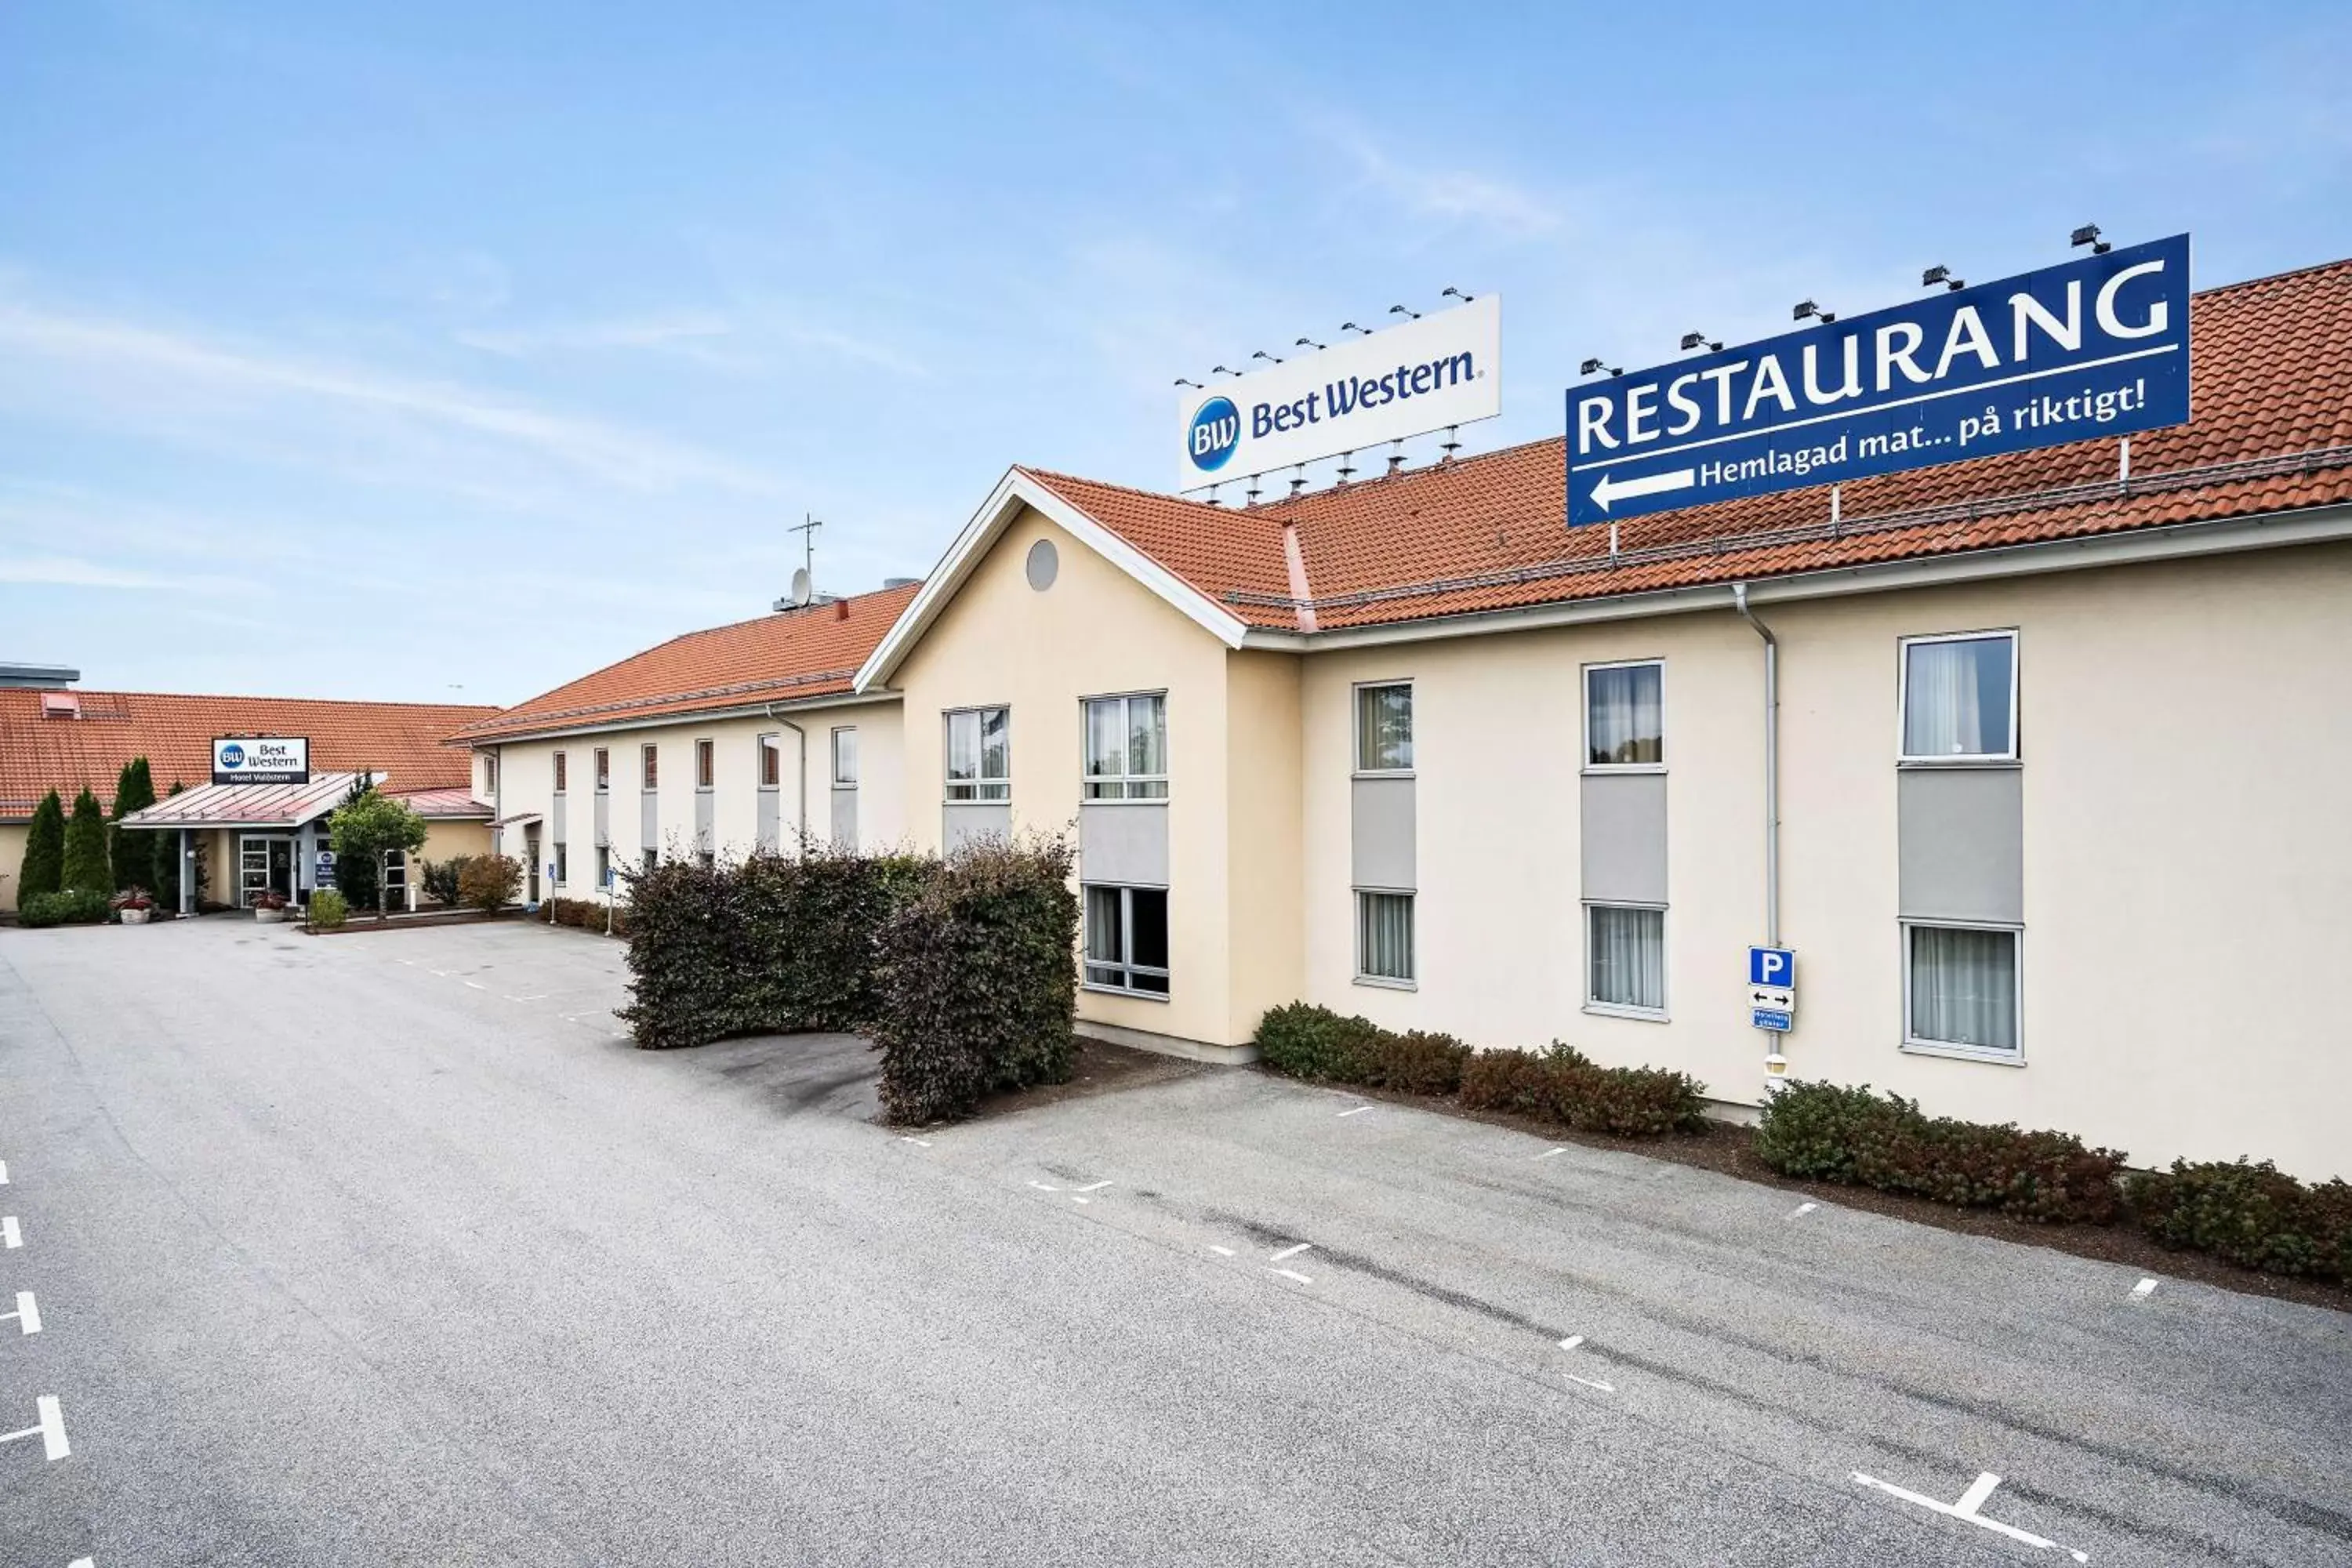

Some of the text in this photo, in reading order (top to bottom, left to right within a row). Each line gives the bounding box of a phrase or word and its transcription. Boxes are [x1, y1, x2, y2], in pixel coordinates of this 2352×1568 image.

[1578, 260, 2168, 454] RESTAURANG
[1253, 391, 1320, 439] Best
[1193, 415, 1236, 456] BW
[1700, 379, 2145, 487] Hemlagad mat... på riktigt!
[222, 752, 243, 763] BW
[248, 756, 298, 768] Western
[260, 744, 286, 755] Best
[1762, 953, 1784, 982] P
